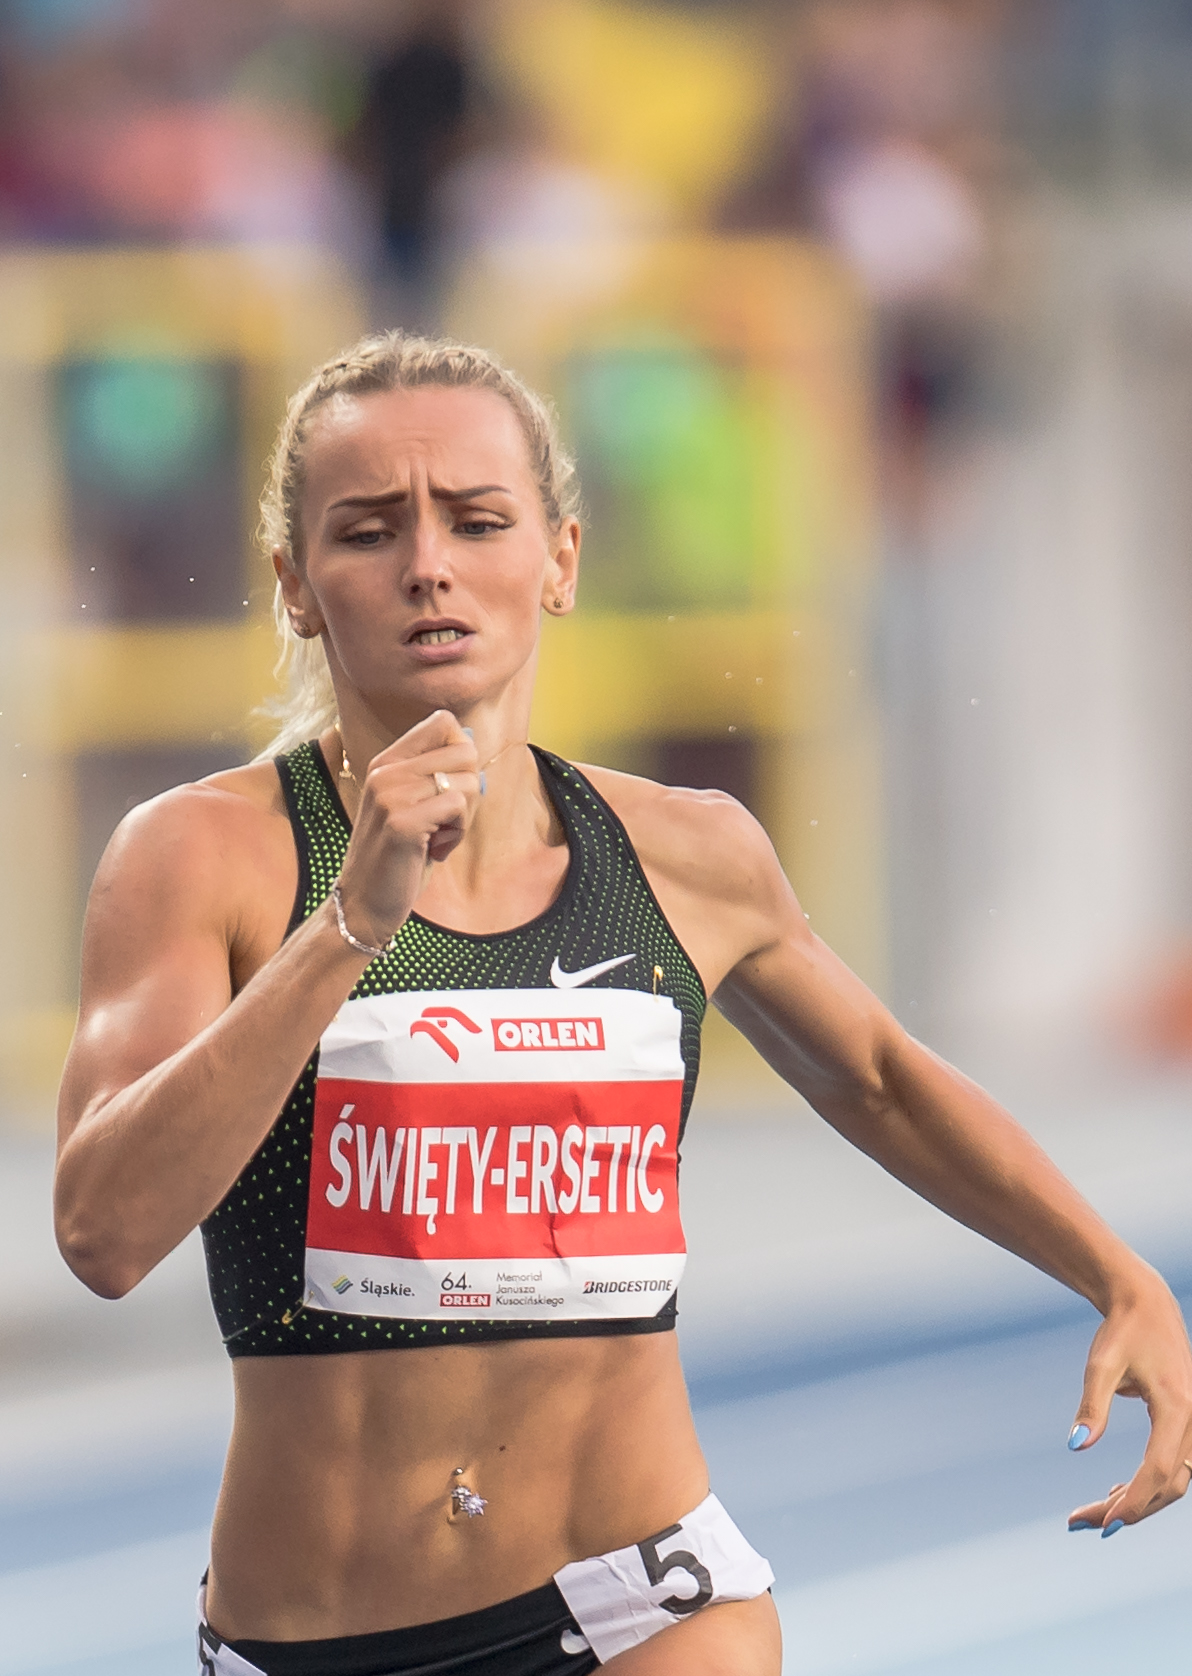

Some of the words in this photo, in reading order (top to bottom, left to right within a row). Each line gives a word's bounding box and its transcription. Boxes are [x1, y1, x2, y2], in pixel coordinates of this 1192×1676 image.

[497, 1020, 598, 1048] ORLEN
[325, 1103, 667, 1235] ŚWIĘTY-ERSETIC
[440, 1271, 472, 1291] 64.
[496, 1284, 536, 1294] Janusza
[582, 1279, 673, 1294] BRIDGESTONE
[442, 1295, 489, 1306] ORLEN
[637, 1523, 714, 1615] 5
